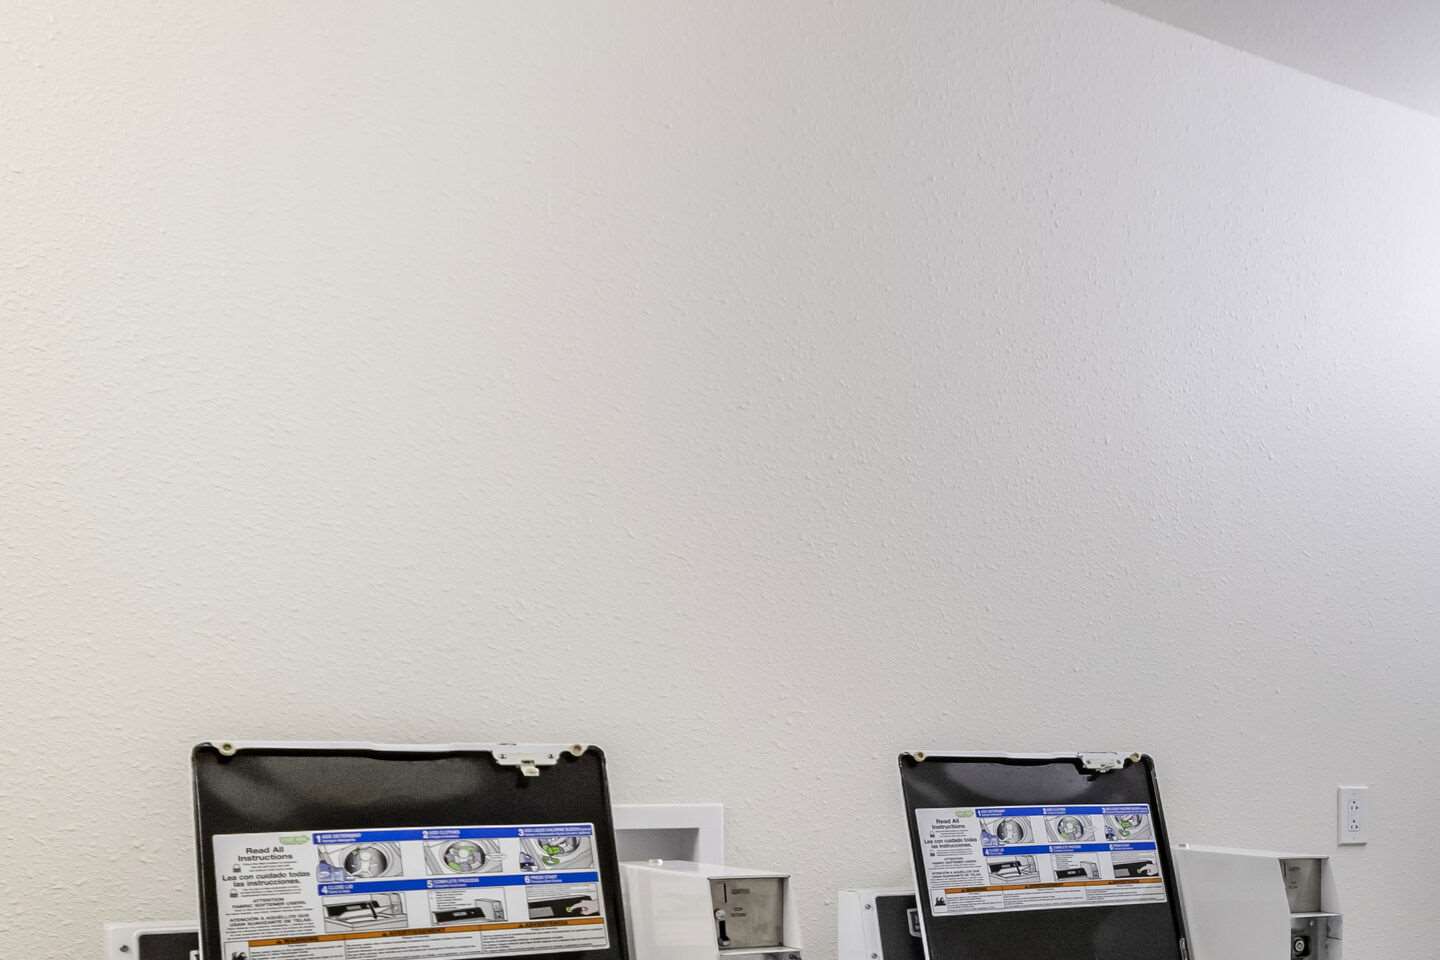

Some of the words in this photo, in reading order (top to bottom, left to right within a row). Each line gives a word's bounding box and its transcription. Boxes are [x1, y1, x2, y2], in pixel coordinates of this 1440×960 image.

[238, 853, 293, 862] Instructions
[222, 874, 237, 882] Lea
[256, 871, 287, 880] cuidado
